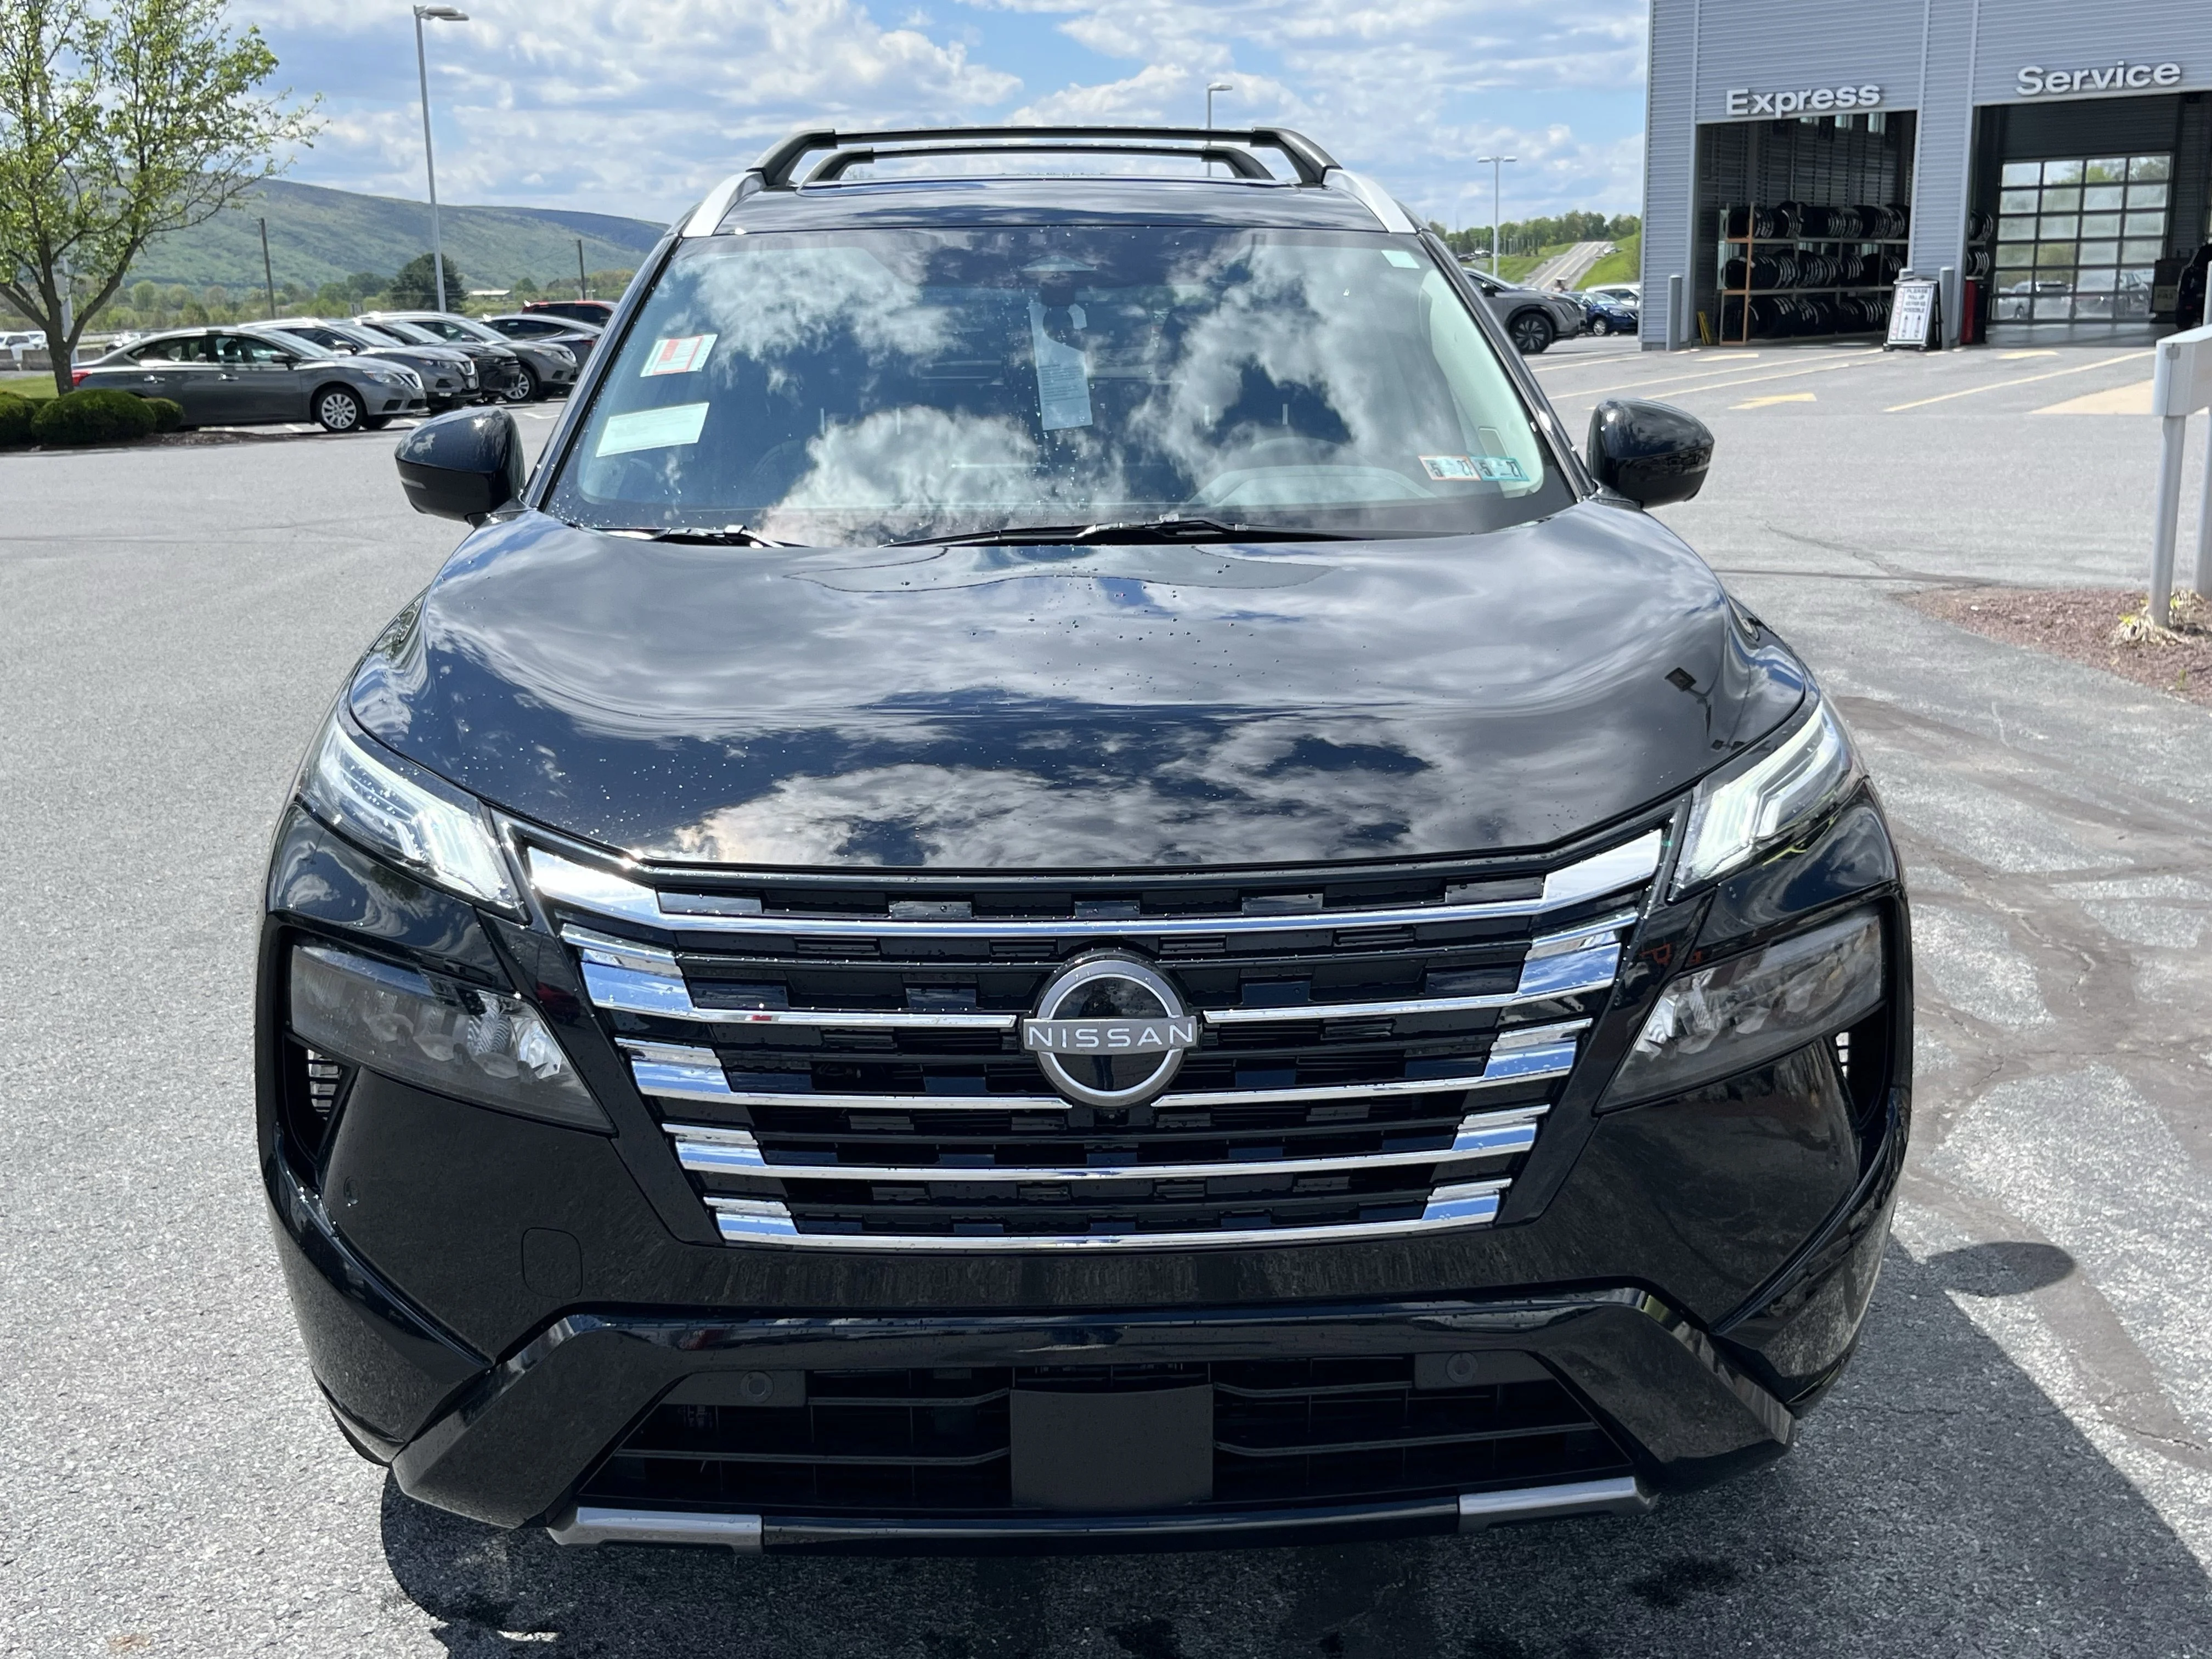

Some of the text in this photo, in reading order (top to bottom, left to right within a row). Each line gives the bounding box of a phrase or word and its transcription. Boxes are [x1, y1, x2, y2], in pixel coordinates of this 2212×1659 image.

[2016, 60, 2181, 95] Service
[1726, 84, 1881, 119] Express
[1029, 1023, 1193, 1048] NISSAN
